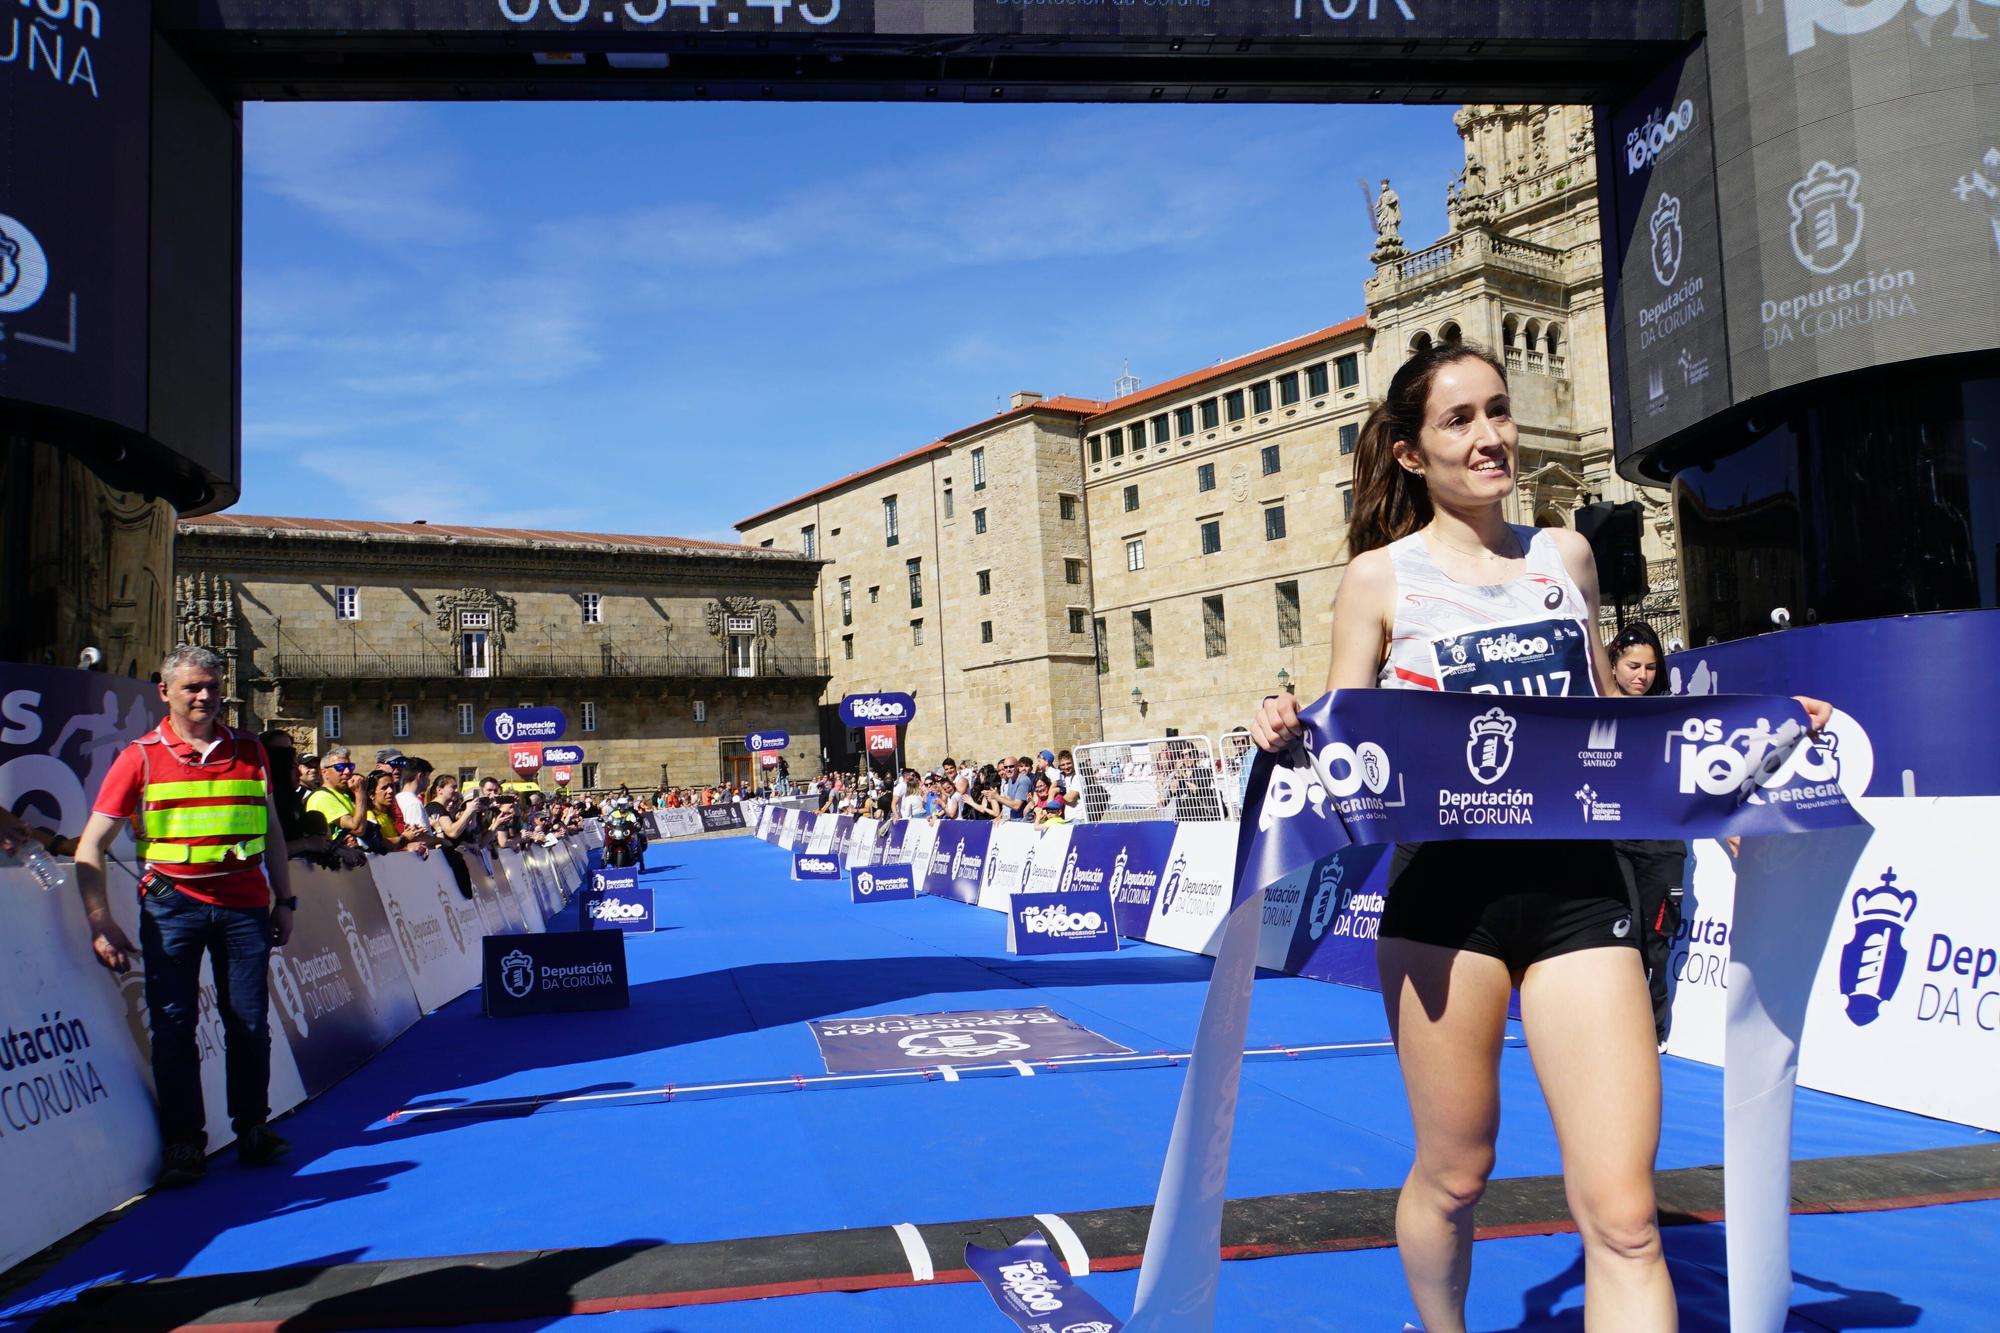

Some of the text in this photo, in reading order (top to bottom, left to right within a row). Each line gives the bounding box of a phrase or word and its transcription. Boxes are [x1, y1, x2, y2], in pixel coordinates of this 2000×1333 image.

[1640, 277, 1704, 328] Deputación
[1761, 269, 1915, 323] Deputación
[1641, 298, 1705, 350] DA CORUÑA
[1763, 293, 1918, 351] DA CORUÑA
[516, 720, 556, 731] Deputación
[517, 726, 556, 737] DA CORUÑA
[1682, 718, 1724, 743] OS
[871, 734, 894, 750] 25M
[513, 752, 540, 768] 25M
[763, 755, 777, 765] 50M
[1578, 751, 1623, 760] CONCELLO DE
[1583, 759, 1616, 767] SANTIAGO
[556, 771, 570, 781] 50M
[1439, 788, 1533, 810] Deputación
[1796, 798, 1840, 810] Deputación
[1439, 805, 1533, 826] DA CORUÑA
[1123, 869, 1157, 889] Deputación
[1181, 877, 1223, 898] Deputación
[1333, 915, 1350, 937] DA
[292, 946, 343, 990] Deputación
[541, 962, 613, 979] Deputación
[542, 973, 614, 991] DA CORUÑA
[1917, 983, 1960, 1026] DA
[823, 1016, 1058, 1037] Deputación
[2, 1058, 109, 1131] CORUÑA
